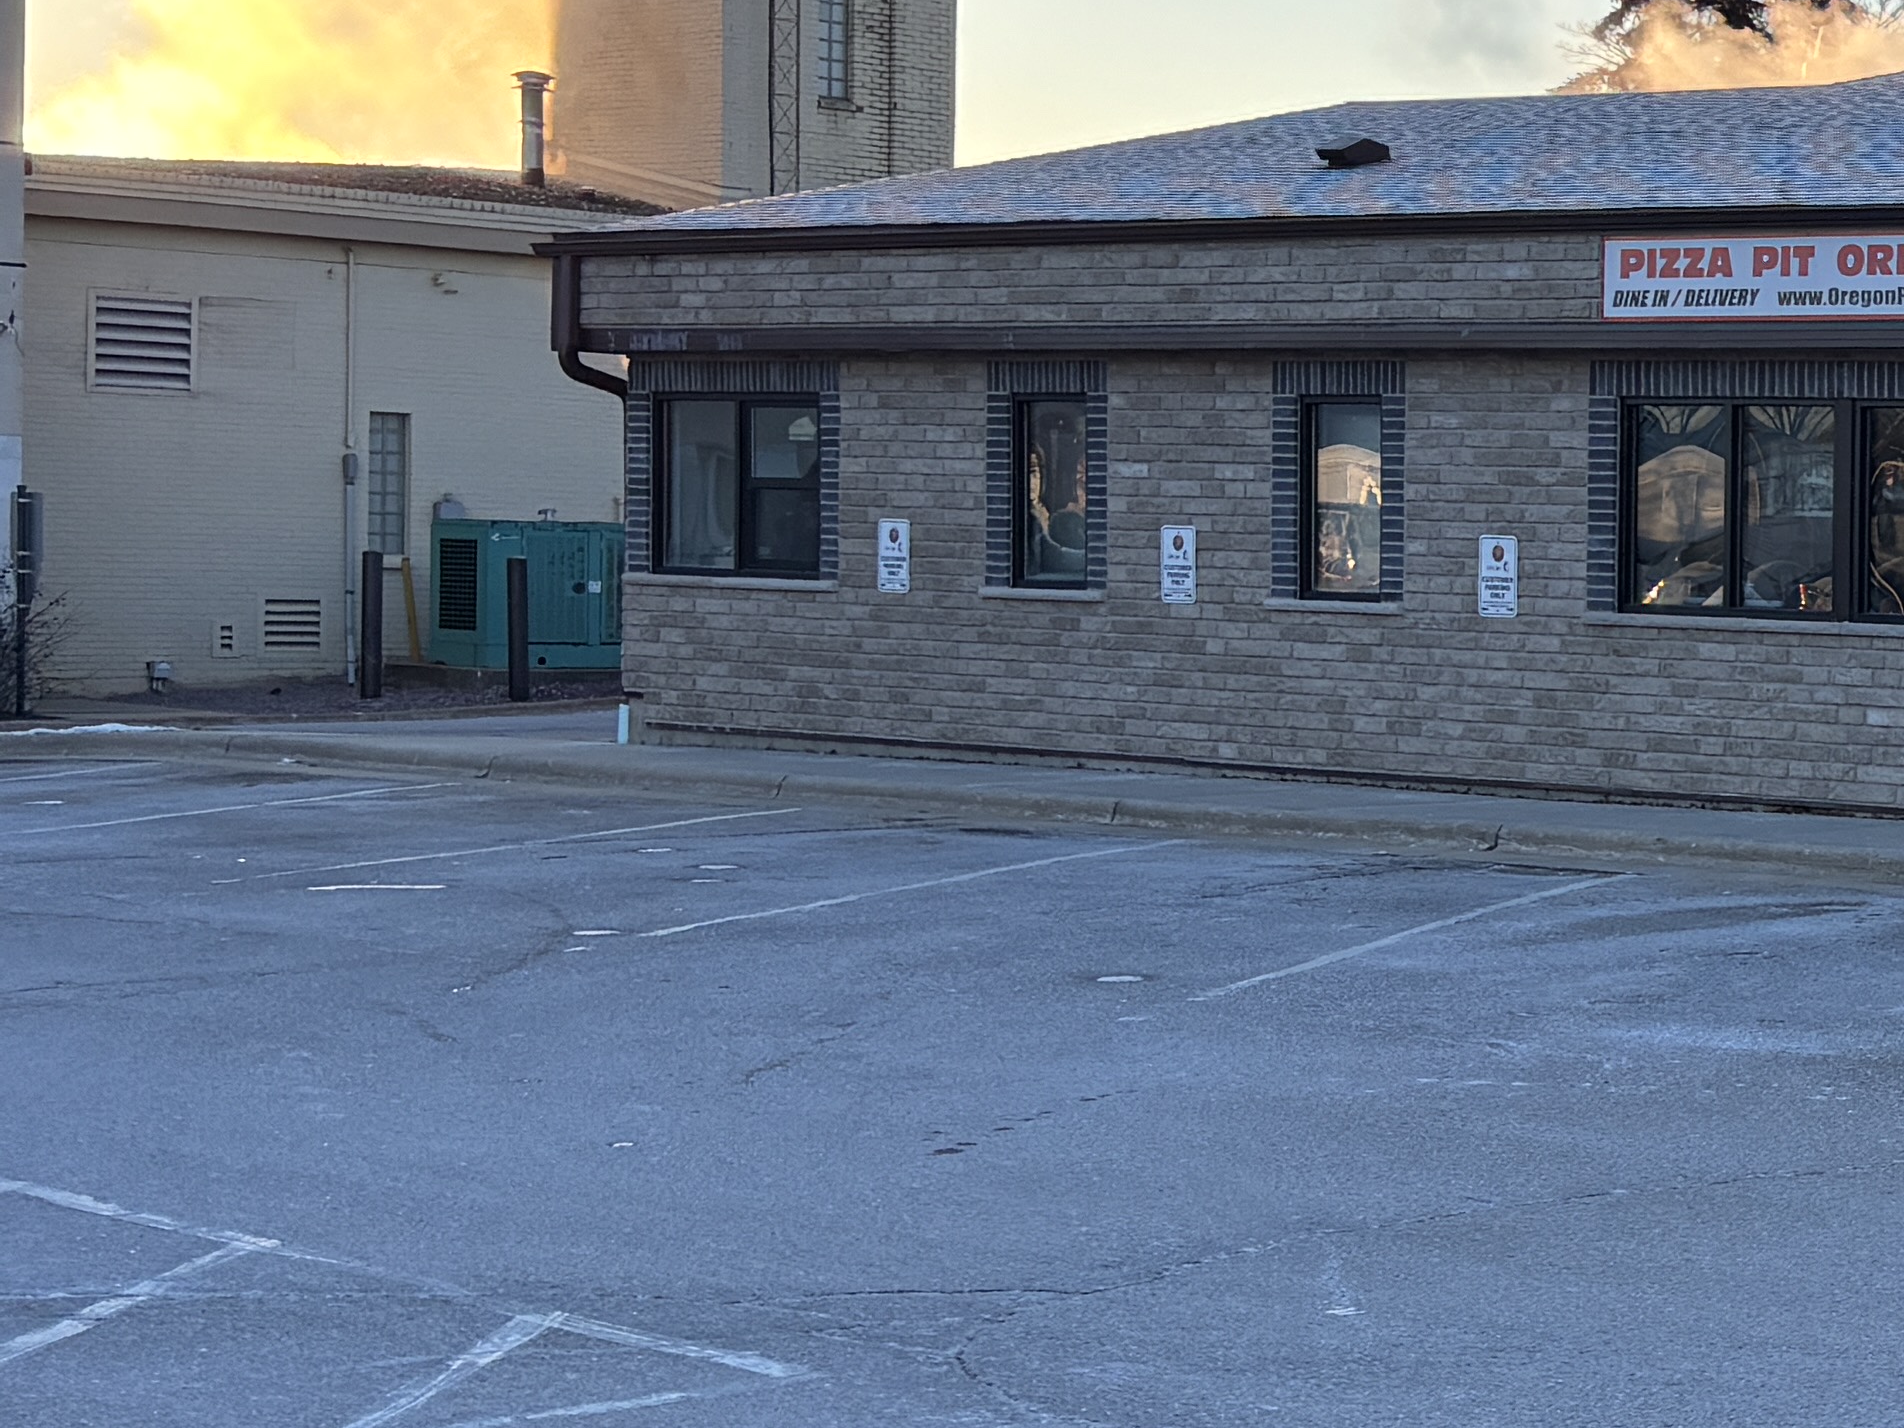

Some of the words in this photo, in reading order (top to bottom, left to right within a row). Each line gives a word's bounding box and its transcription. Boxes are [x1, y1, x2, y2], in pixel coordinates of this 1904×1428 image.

[1620, 247, 1733, 279] PIZZA
[1752, 245, 1815, 277] PIT
[1612, 289, 1650, 307] DINE
[1651, 289, 1670, 307] IN
[1684, 288, 1760, 307] DELIVERY
